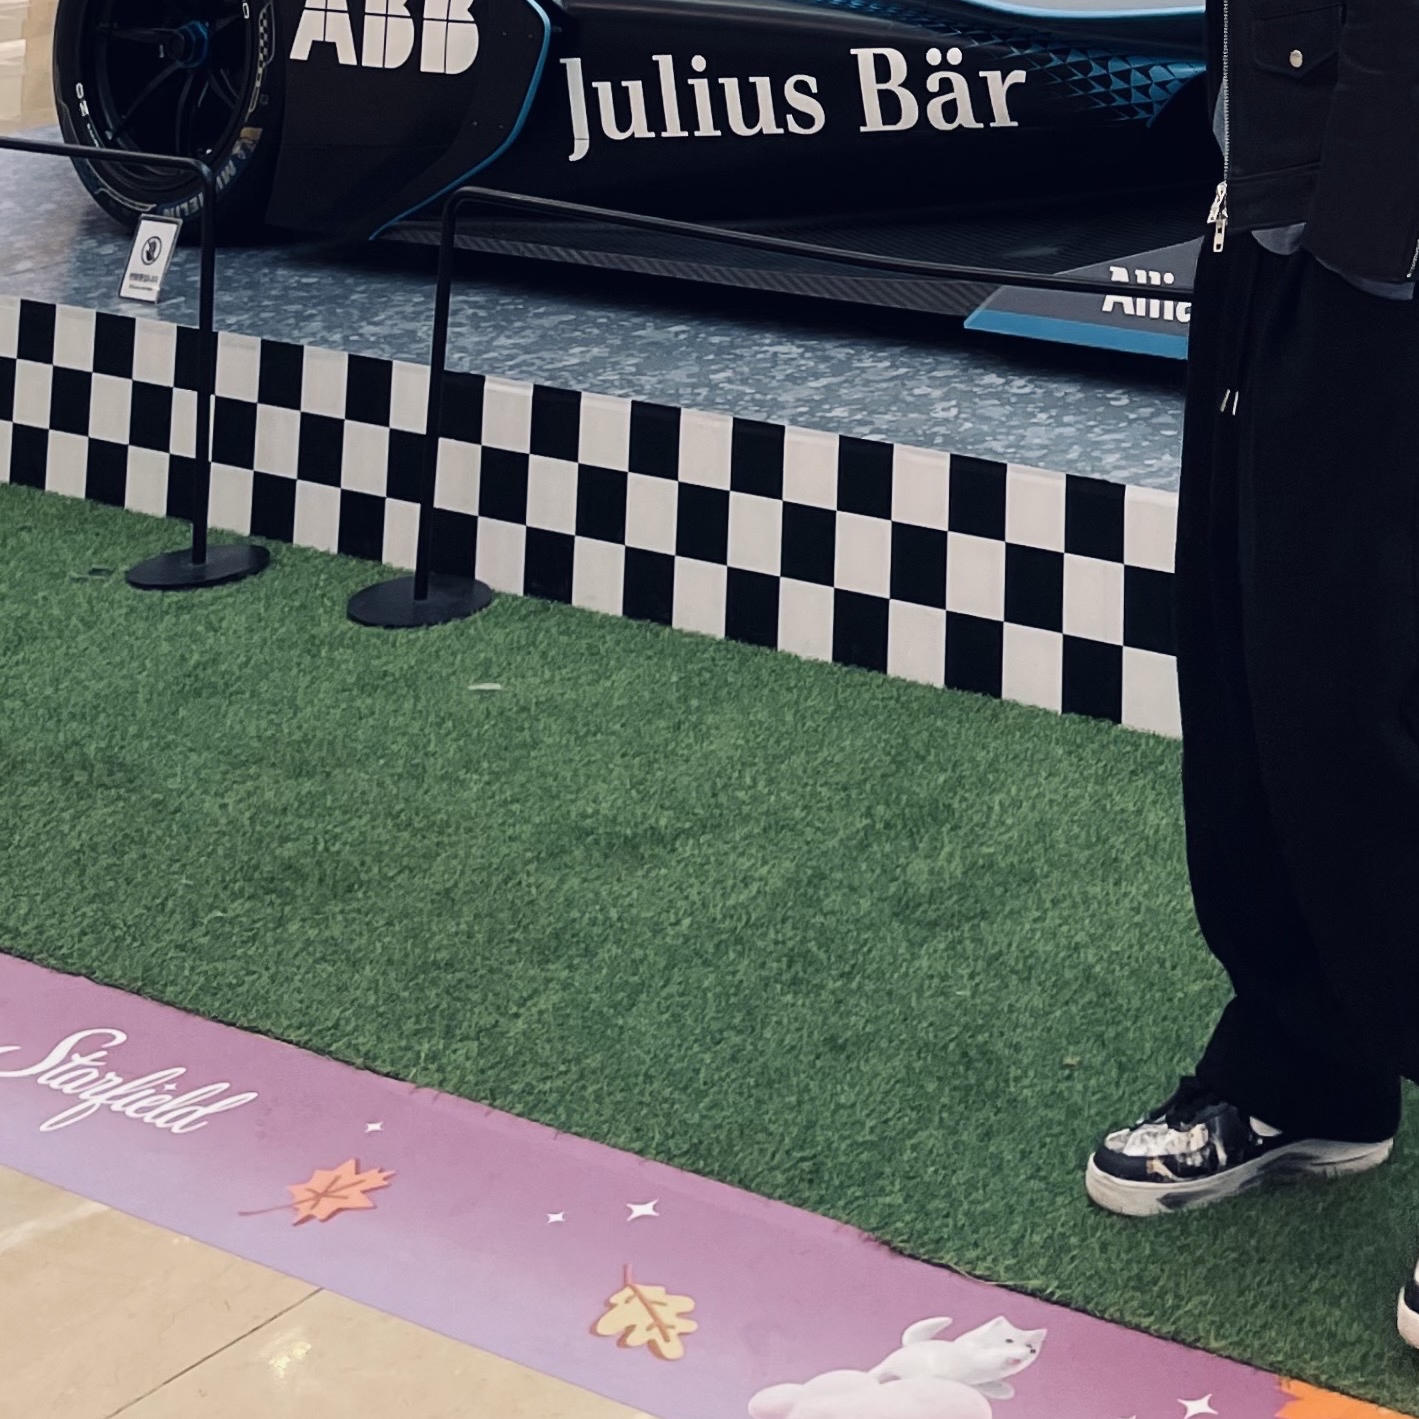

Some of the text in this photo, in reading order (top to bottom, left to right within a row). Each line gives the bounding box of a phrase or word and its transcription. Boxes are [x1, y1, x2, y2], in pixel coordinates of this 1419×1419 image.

[559, 46, 1027, 162] Julius Bär
[0, 1028, 258, 1133] Starfield
